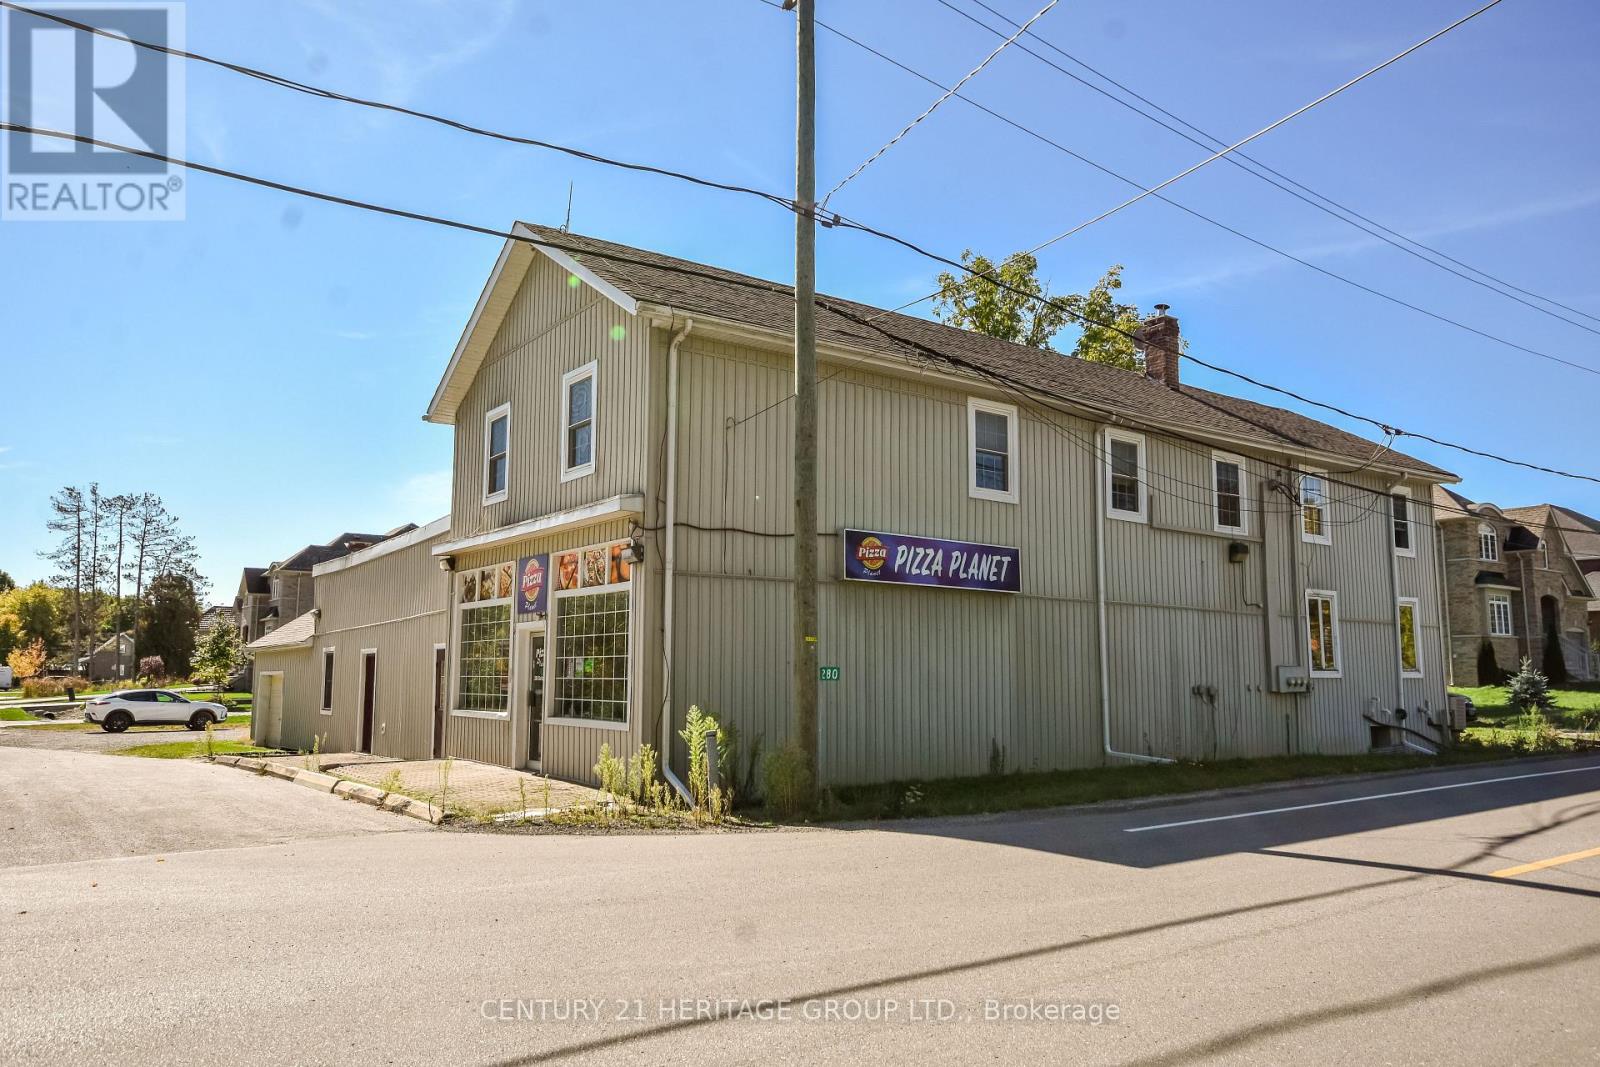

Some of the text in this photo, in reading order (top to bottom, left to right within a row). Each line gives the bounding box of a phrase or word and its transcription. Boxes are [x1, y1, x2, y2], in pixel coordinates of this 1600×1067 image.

[858, 546, 887, 558] Pizza
[894, 545, 1012, 582] PIZZA PLANET
[522, 572, 542, 588] Pizza
[821, 668, 838, 680] 280
